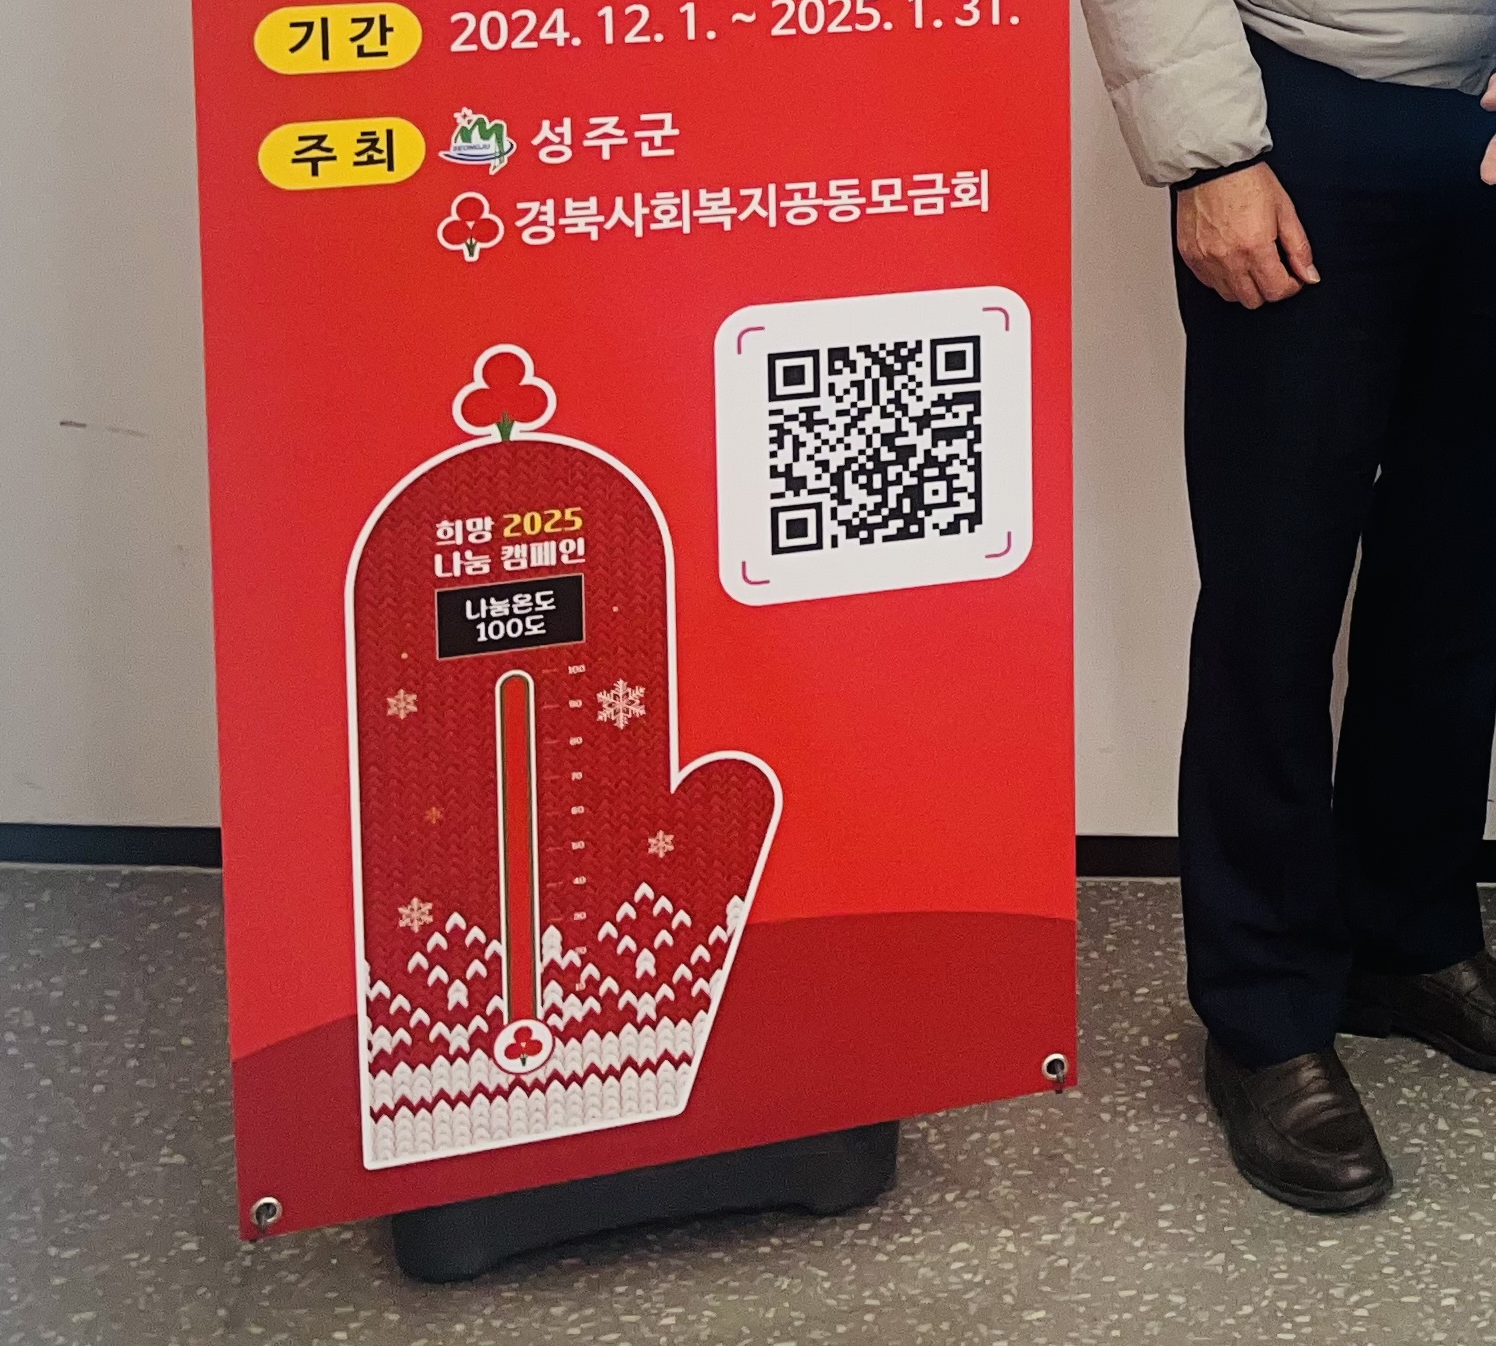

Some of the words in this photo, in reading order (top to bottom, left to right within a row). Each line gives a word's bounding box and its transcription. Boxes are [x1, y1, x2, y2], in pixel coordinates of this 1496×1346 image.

[450, 8, 581, 52] 2024.
[597, 4, 664, 44] 12.
[679, 2, 716, 40] 1.
[531, 111, 680, 164] 성주군
[515, 169, 990, 245] 경북사회복지공동모금회
[435, 516, 494, 545] 희망
[502, 507, 583, 538] 2025
[434, 550, 491, 578] 나눔
[501, 537, 585, 571] 캠페인
[465, 590, 556, 620] 나눔온도
[476, 614, 546, 642] 100도
